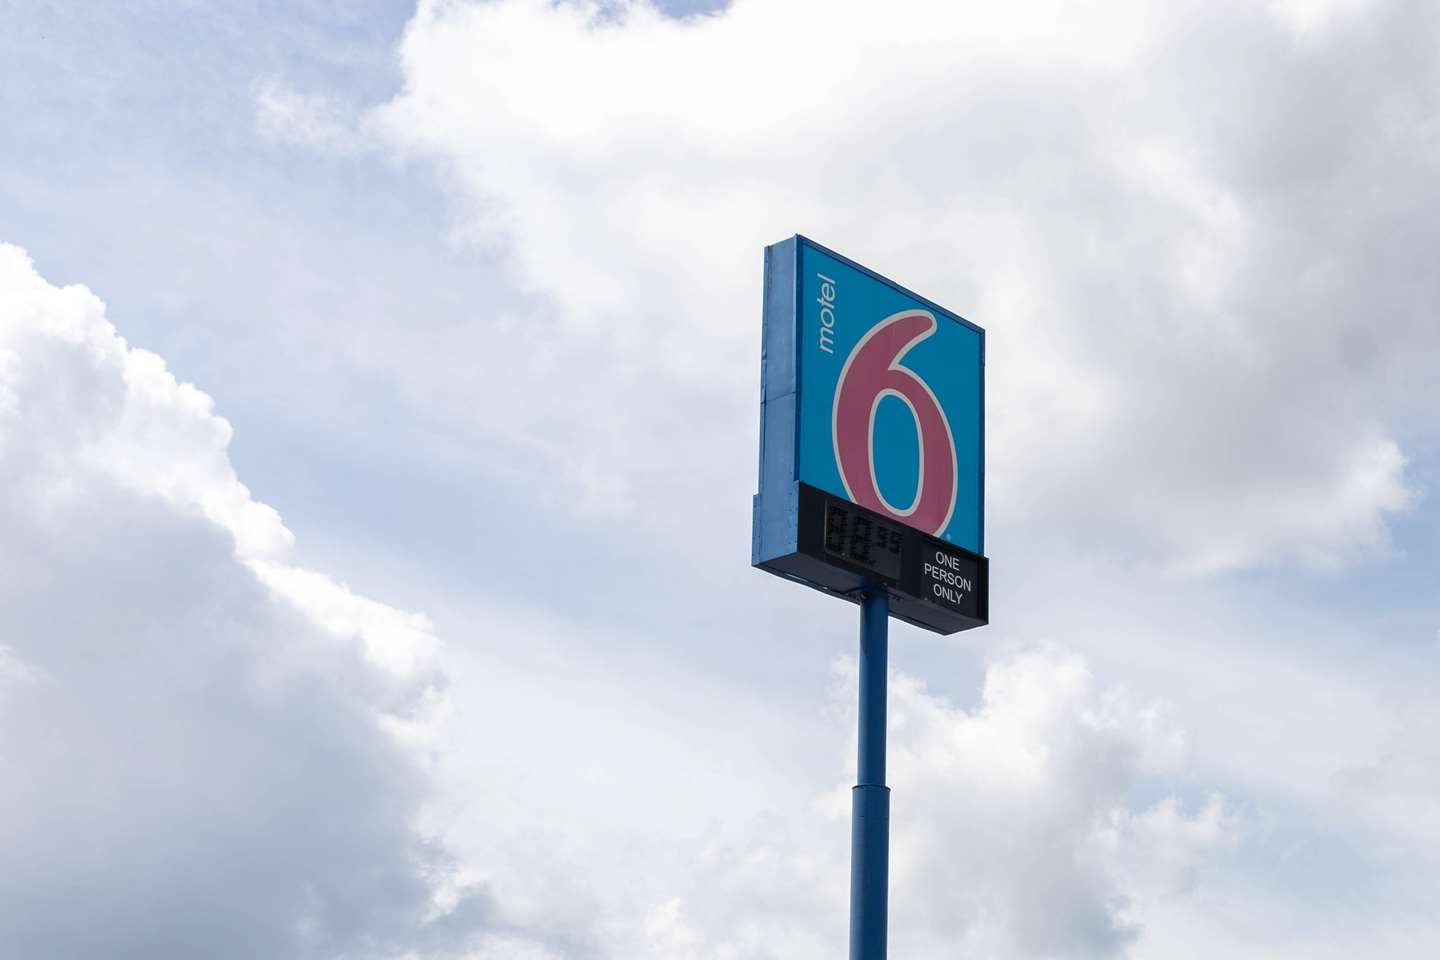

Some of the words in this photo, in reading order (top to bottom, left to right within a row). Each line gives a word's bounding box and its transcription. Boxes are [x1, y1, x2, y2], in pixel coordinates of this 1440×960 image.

[818, 273, 837, 354] motel
[832, 309, 958, 539] 6
[935, 551, 960, 571] ONE
[924, 563, 971, 592] PERSON
[933, 583, 963, 604] ONLY
